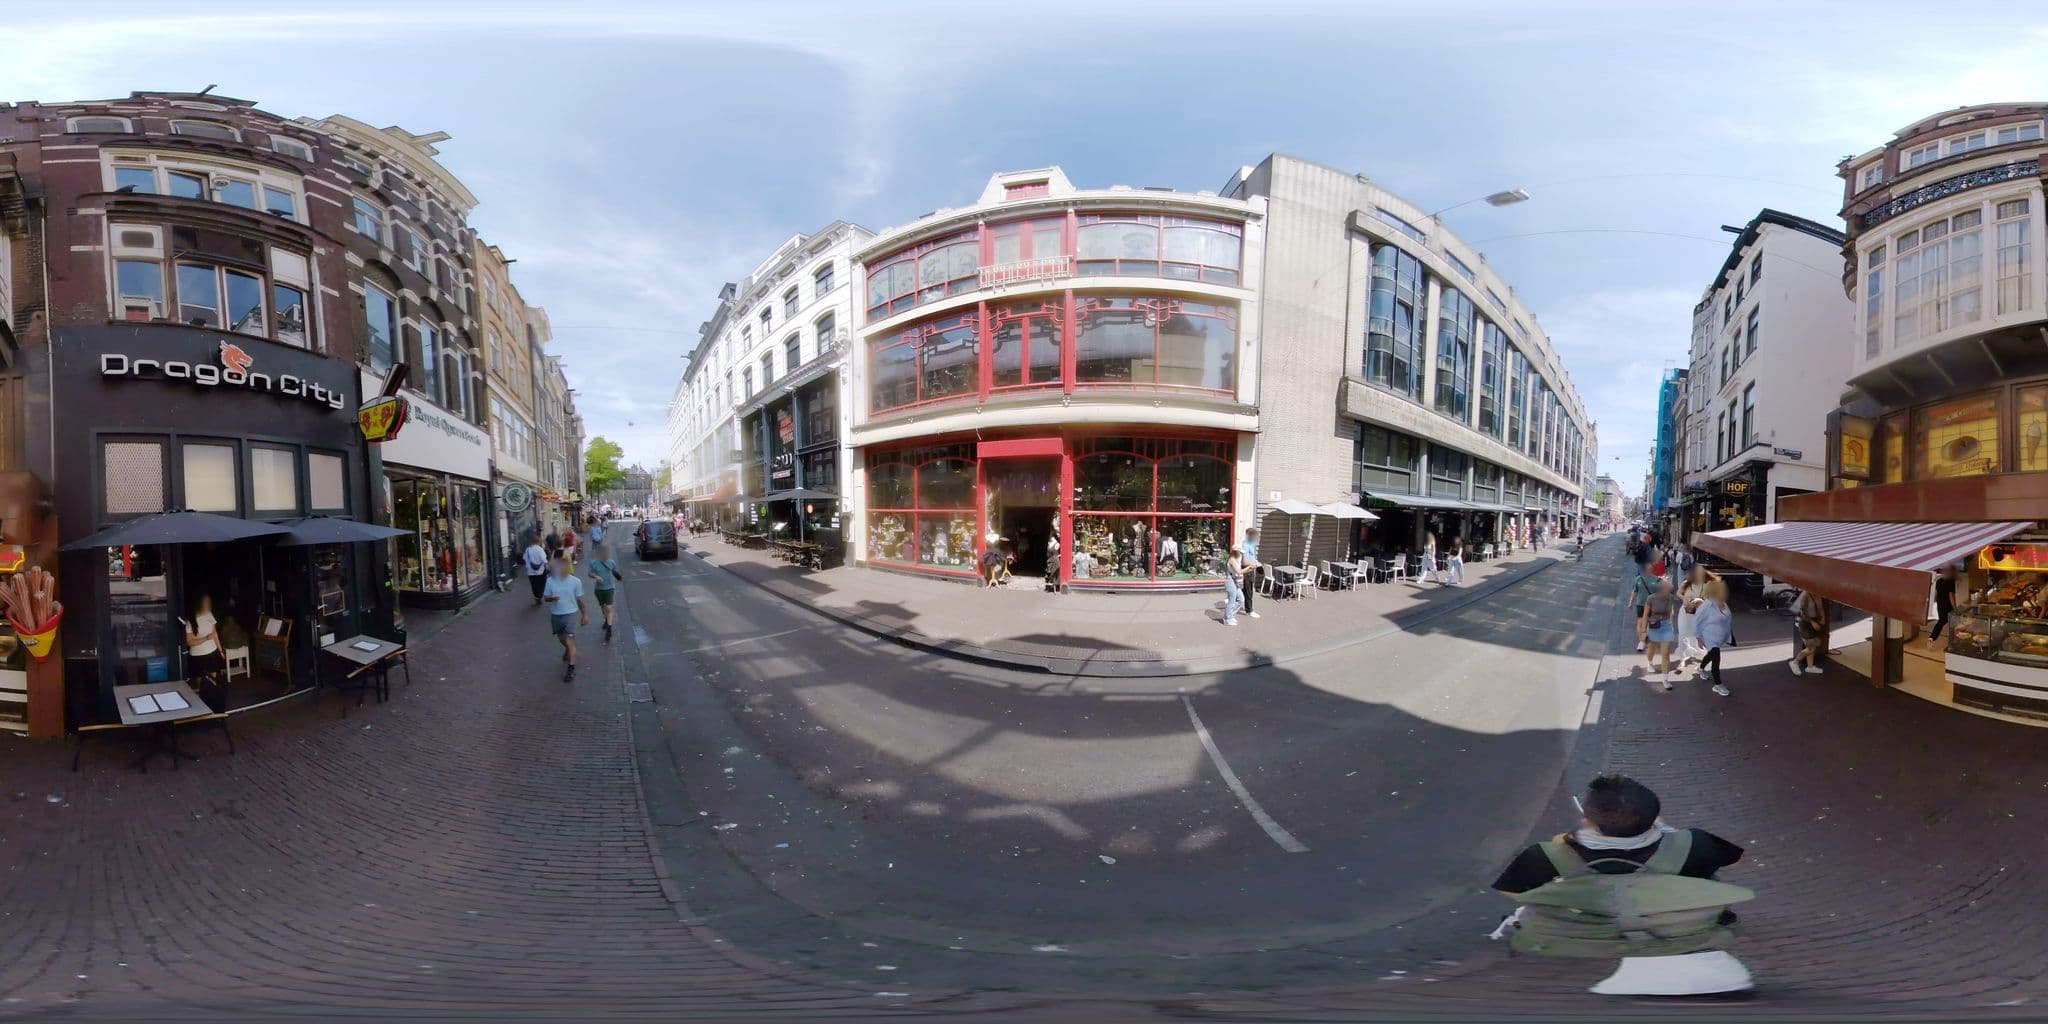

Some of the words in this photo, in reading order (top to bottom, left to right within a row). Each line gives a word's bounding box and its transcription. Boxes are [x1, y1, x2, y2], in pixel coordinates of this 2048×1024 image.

[101, 354, 272, 390] Dragon
[280, 374, 344, 410] City
[1727, 482, 1748, 491] HOF
